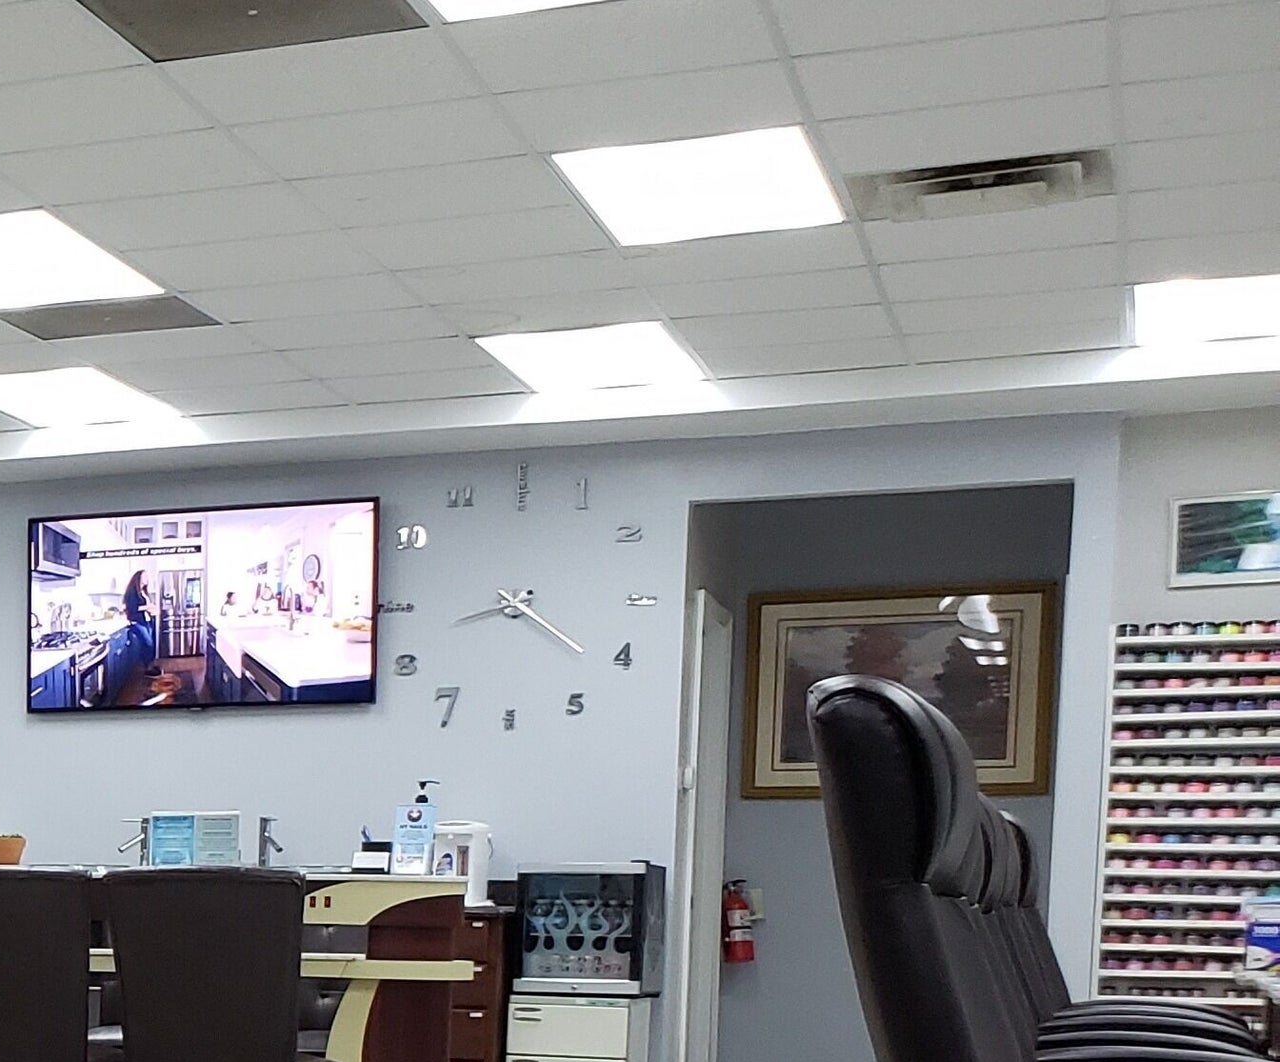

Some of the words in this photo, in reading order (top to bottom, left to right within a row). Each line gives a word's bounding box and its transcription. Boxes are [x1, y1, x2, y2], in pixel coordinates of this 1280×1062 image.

[446, 486, 474, 508] 11
[396, 524, 427, 550] 10
[615, 526, 643, 543] 2
[393, 654, 418, 677] 8
[613, 642, 632, 671] 4
[434, 687, 460, 728] 7
[566, 692, 585, 715] 5
